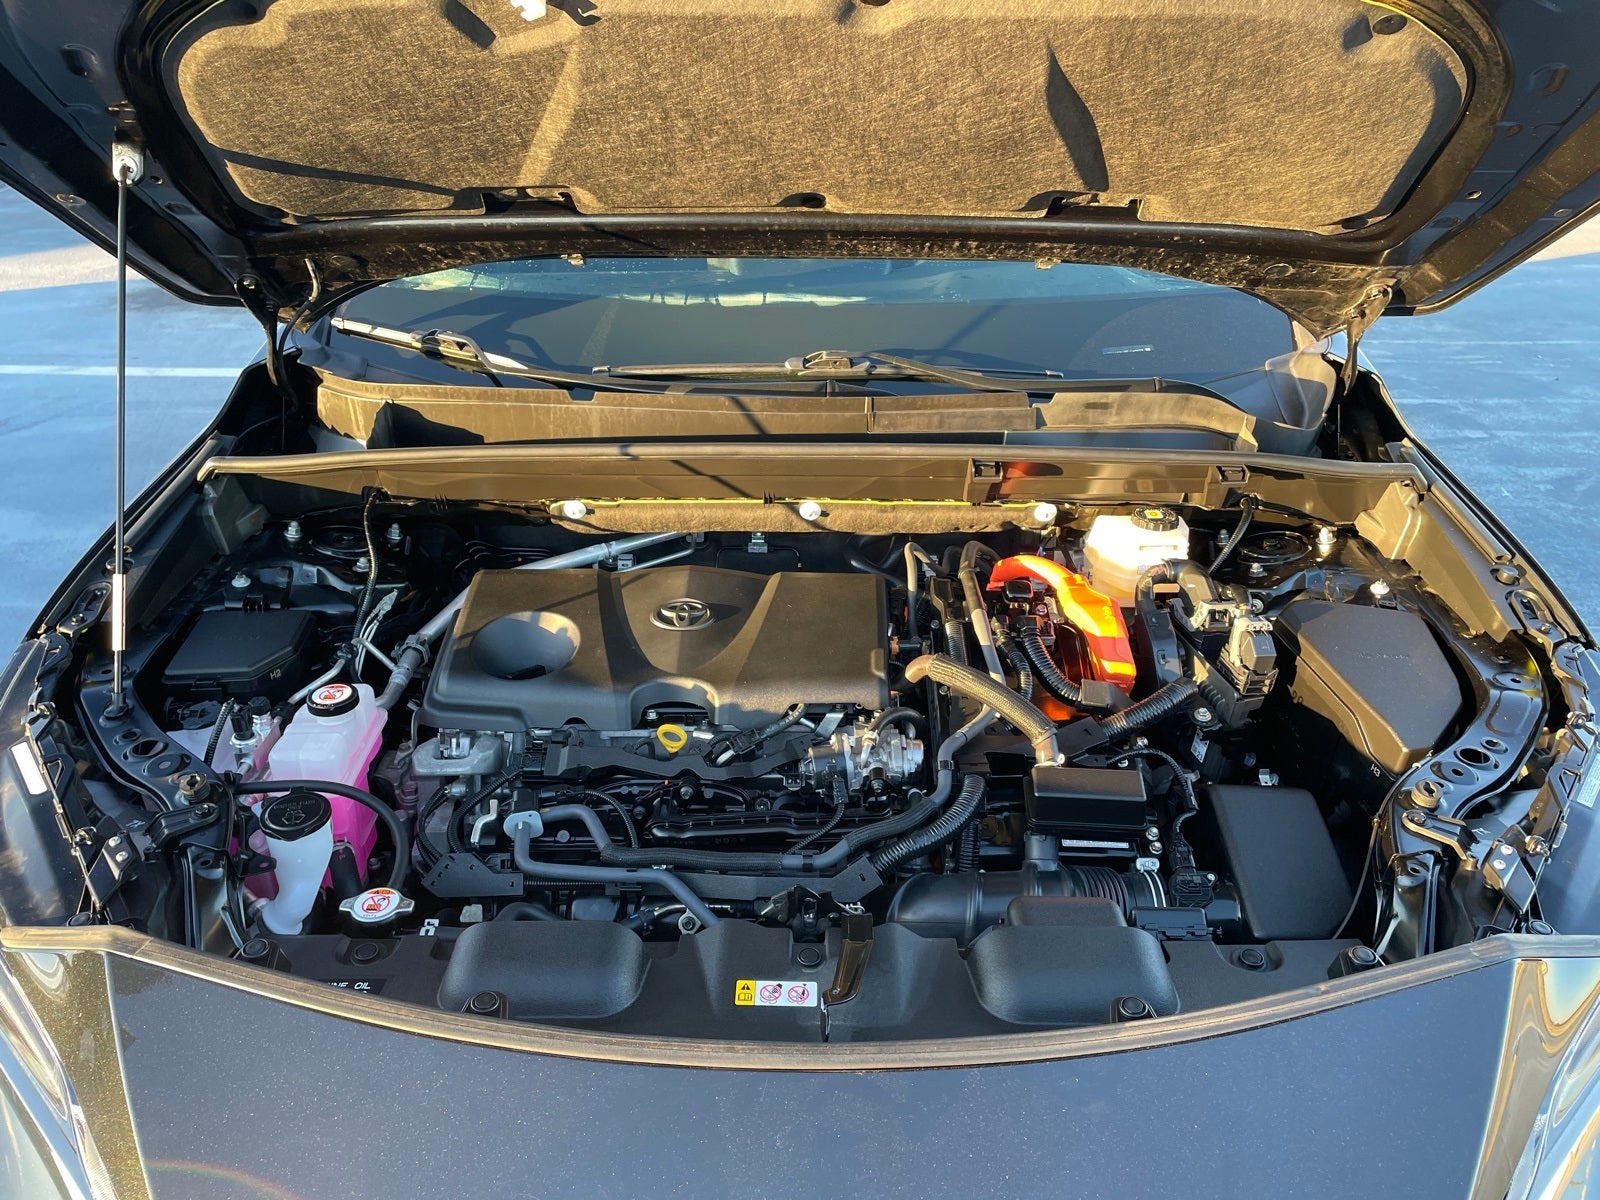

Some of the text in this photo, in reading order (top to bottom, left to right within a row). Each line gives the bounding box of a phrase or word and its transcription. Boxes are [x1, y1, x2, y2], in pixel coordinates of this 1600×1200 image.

[270, 669, 281, 680] H2
[1370, 763, 1381, 777] H3
[354, 982, 371, 990] OIL
